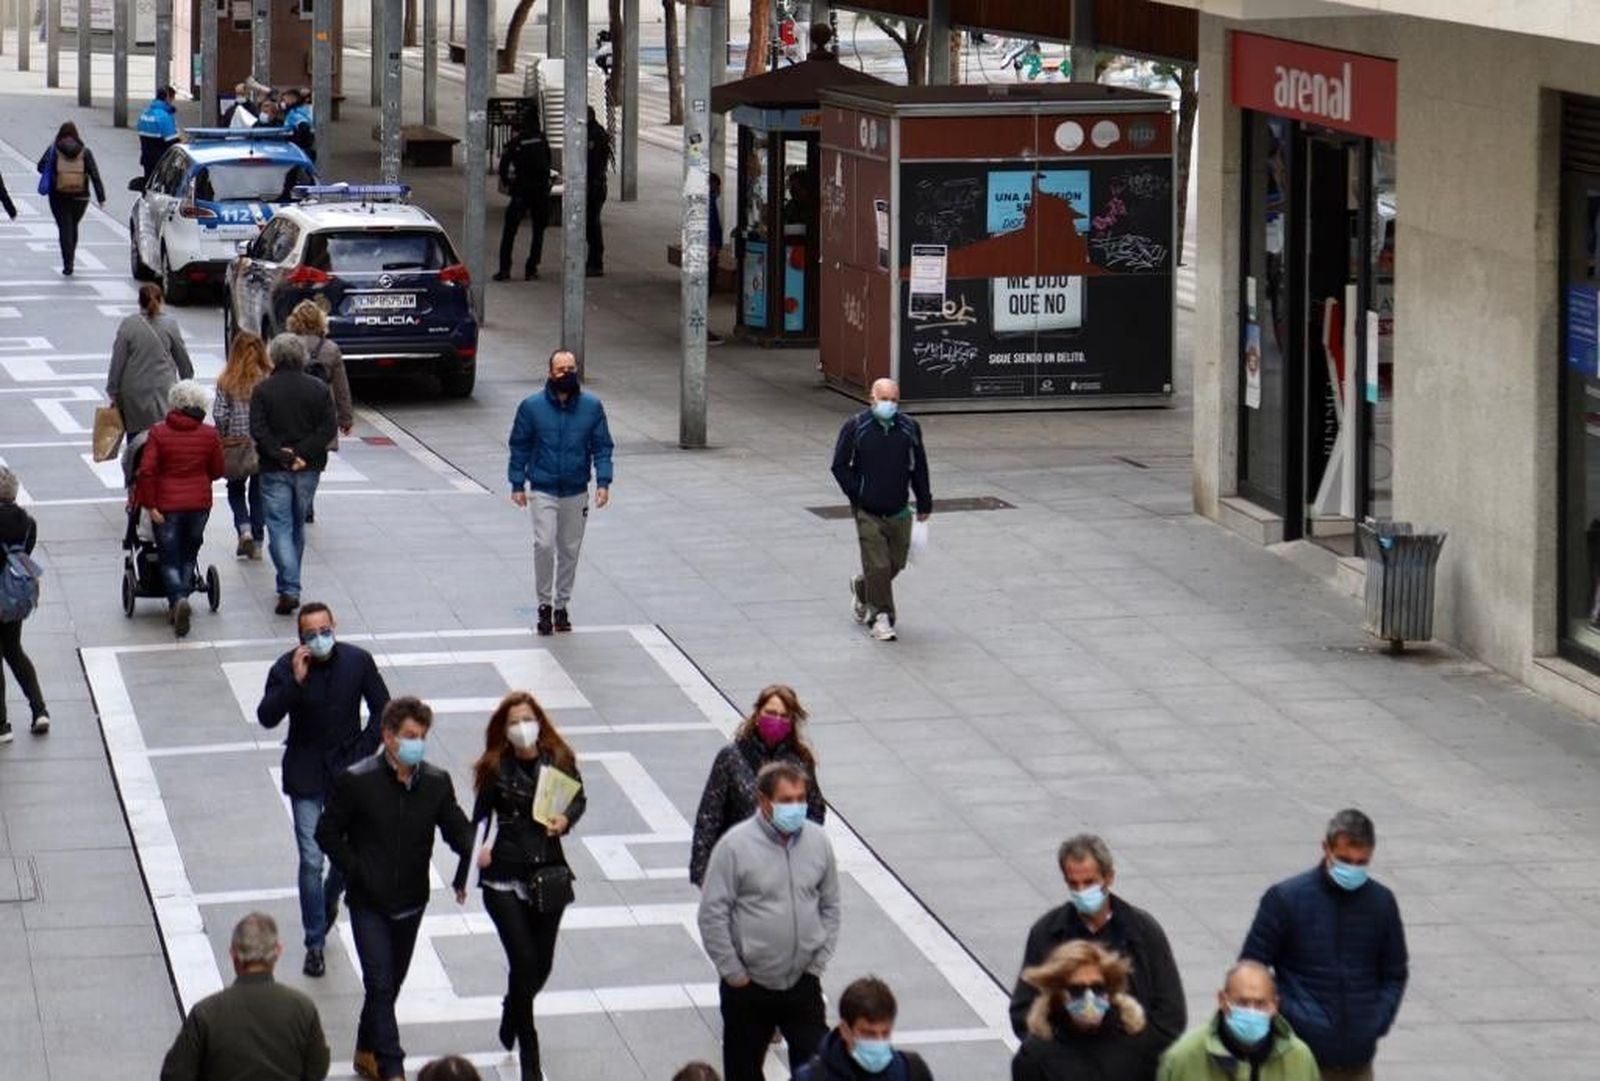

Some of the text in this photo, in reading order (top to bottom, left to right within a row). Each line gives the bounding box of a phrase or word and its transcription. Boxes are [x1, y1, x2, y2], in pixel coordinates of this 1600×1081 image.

[1274, 62, 1351, 122] arenal
[995, 192, 1019, 202] UNA
[221, 209, 251, 222] 112
[1007, 275, 1068, 289] ME DIJO
[1009, 293, 1066, 315] QUE NO
[988, 353, 1011, 364] SIGUE
[1013, 353, 1042, 363] SIENDO
[1044, 353, 1055, 363] UN
